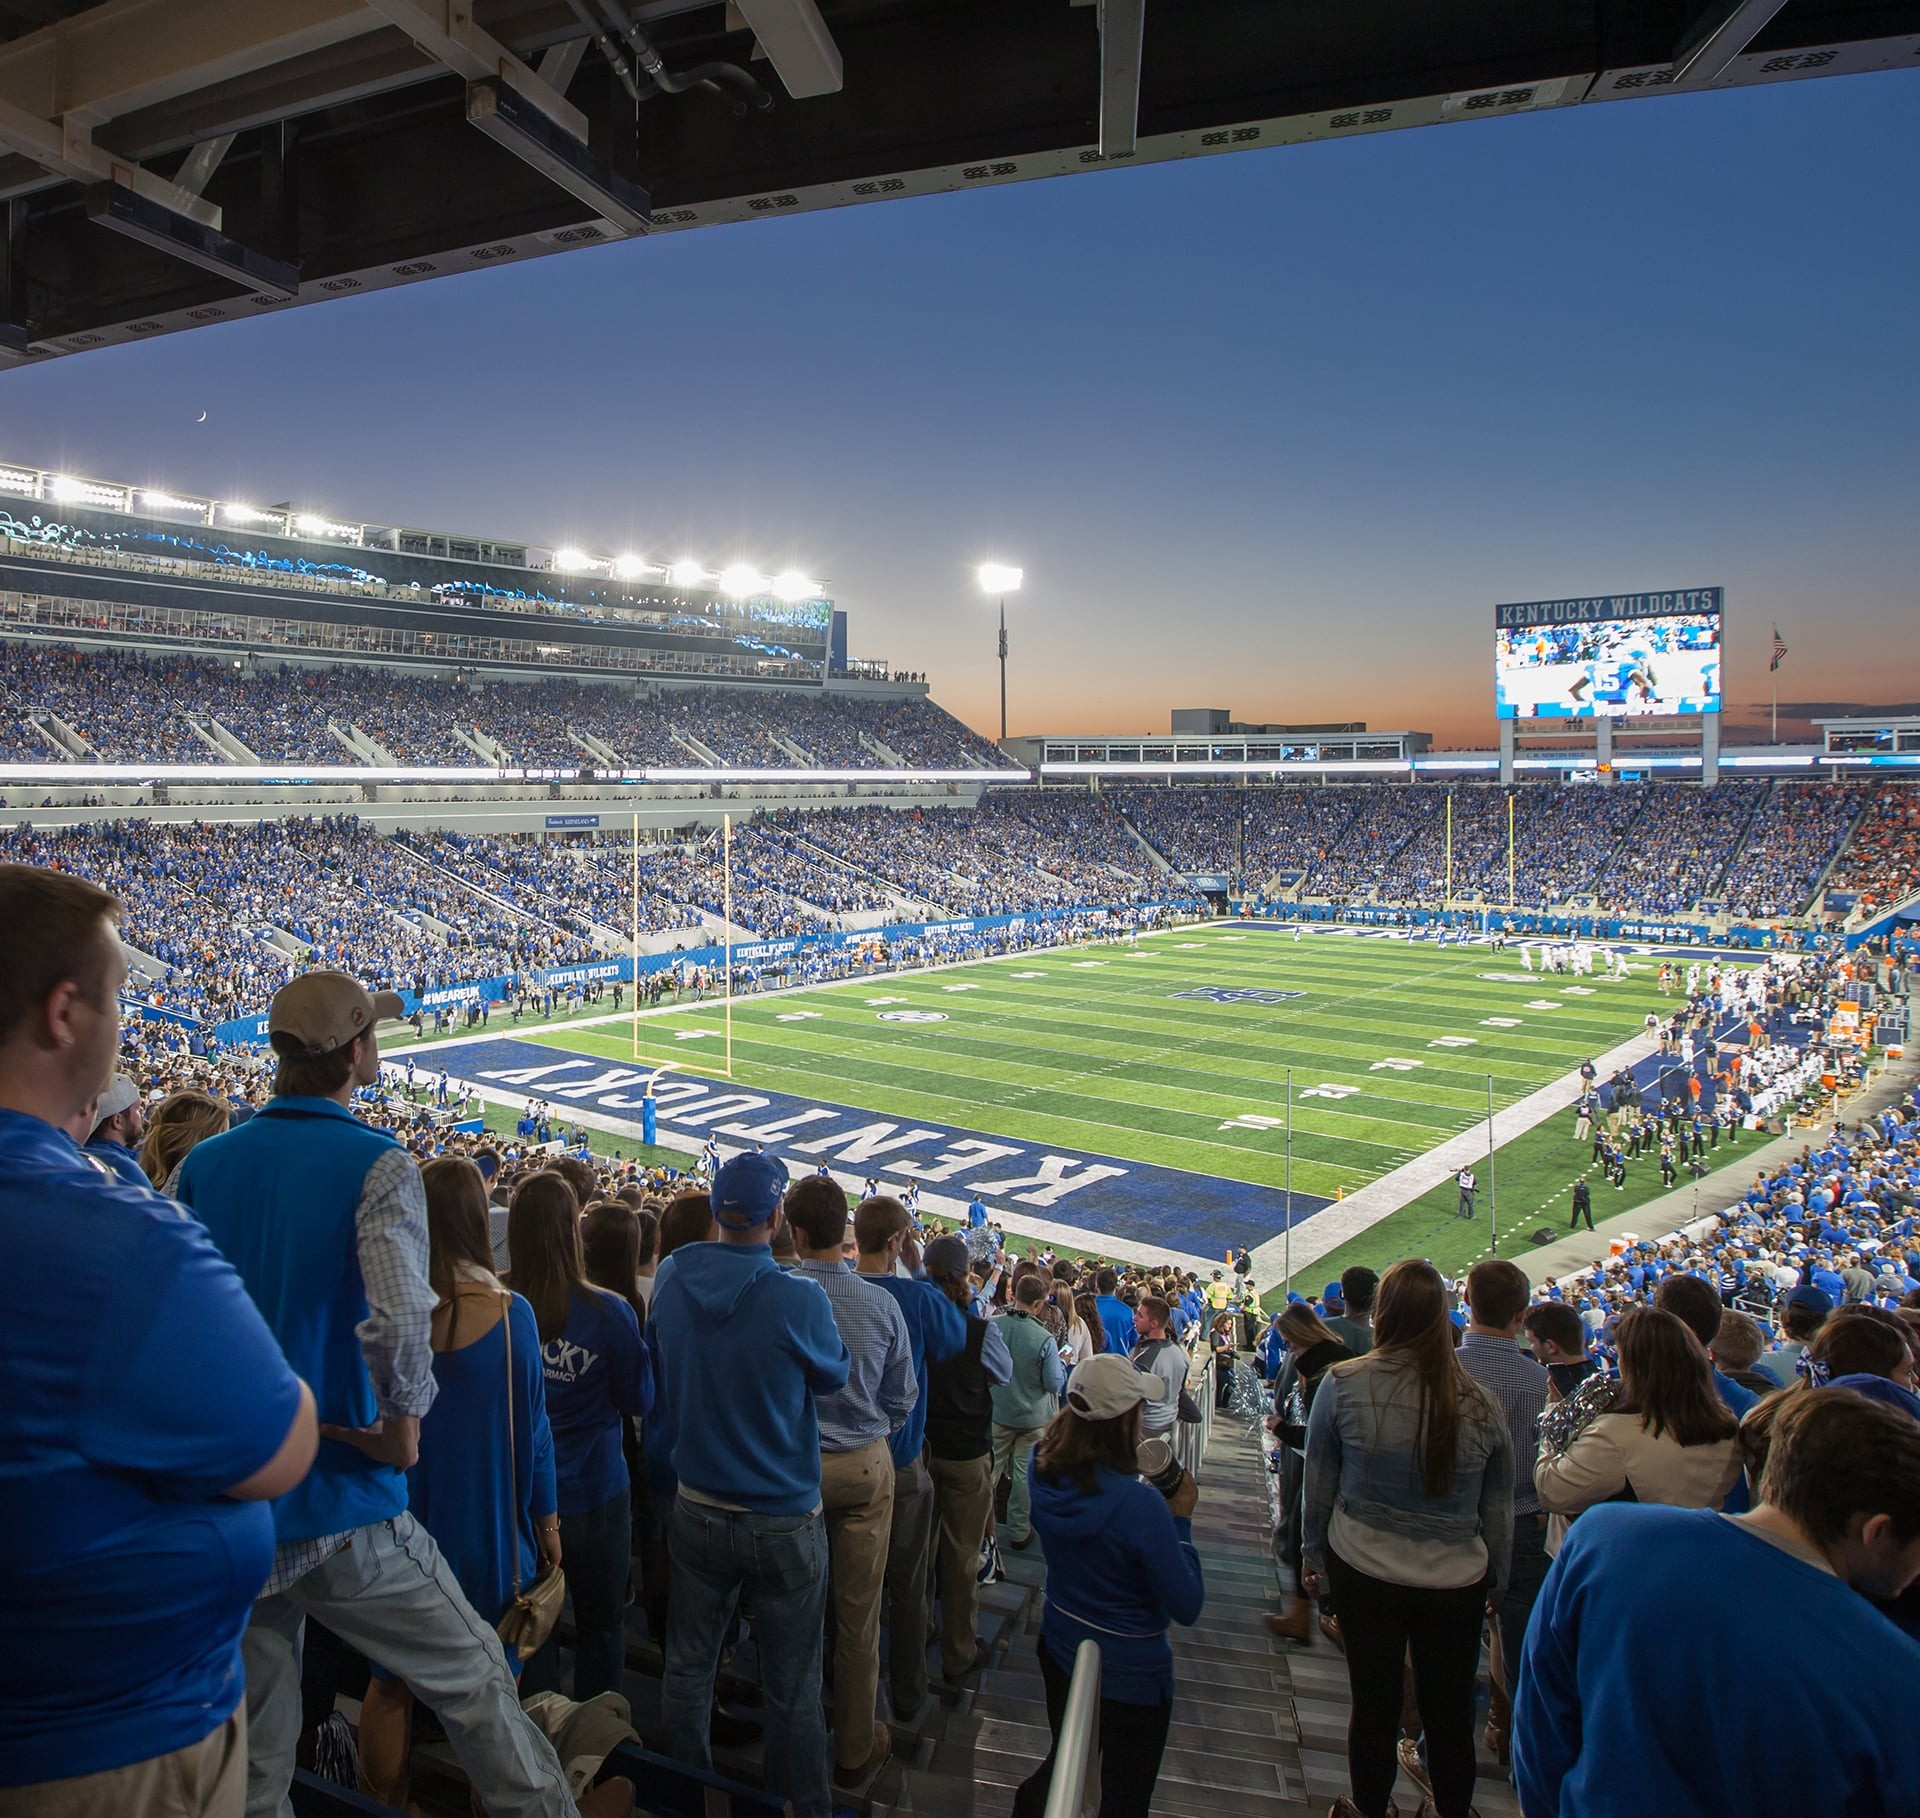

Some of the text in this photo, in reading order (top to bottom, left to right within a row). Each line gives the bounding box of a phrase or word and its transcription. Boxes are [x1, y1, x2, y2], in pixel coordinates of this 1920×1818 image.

[1502, 590, 1714, 625] KENTUCKY WILDCATS
[422, 985, 480, 1006] #WEAREUK
[476, 1059, 1130, 1206] KENTUCKY
[541, 1338, 599, 1376] CKY
